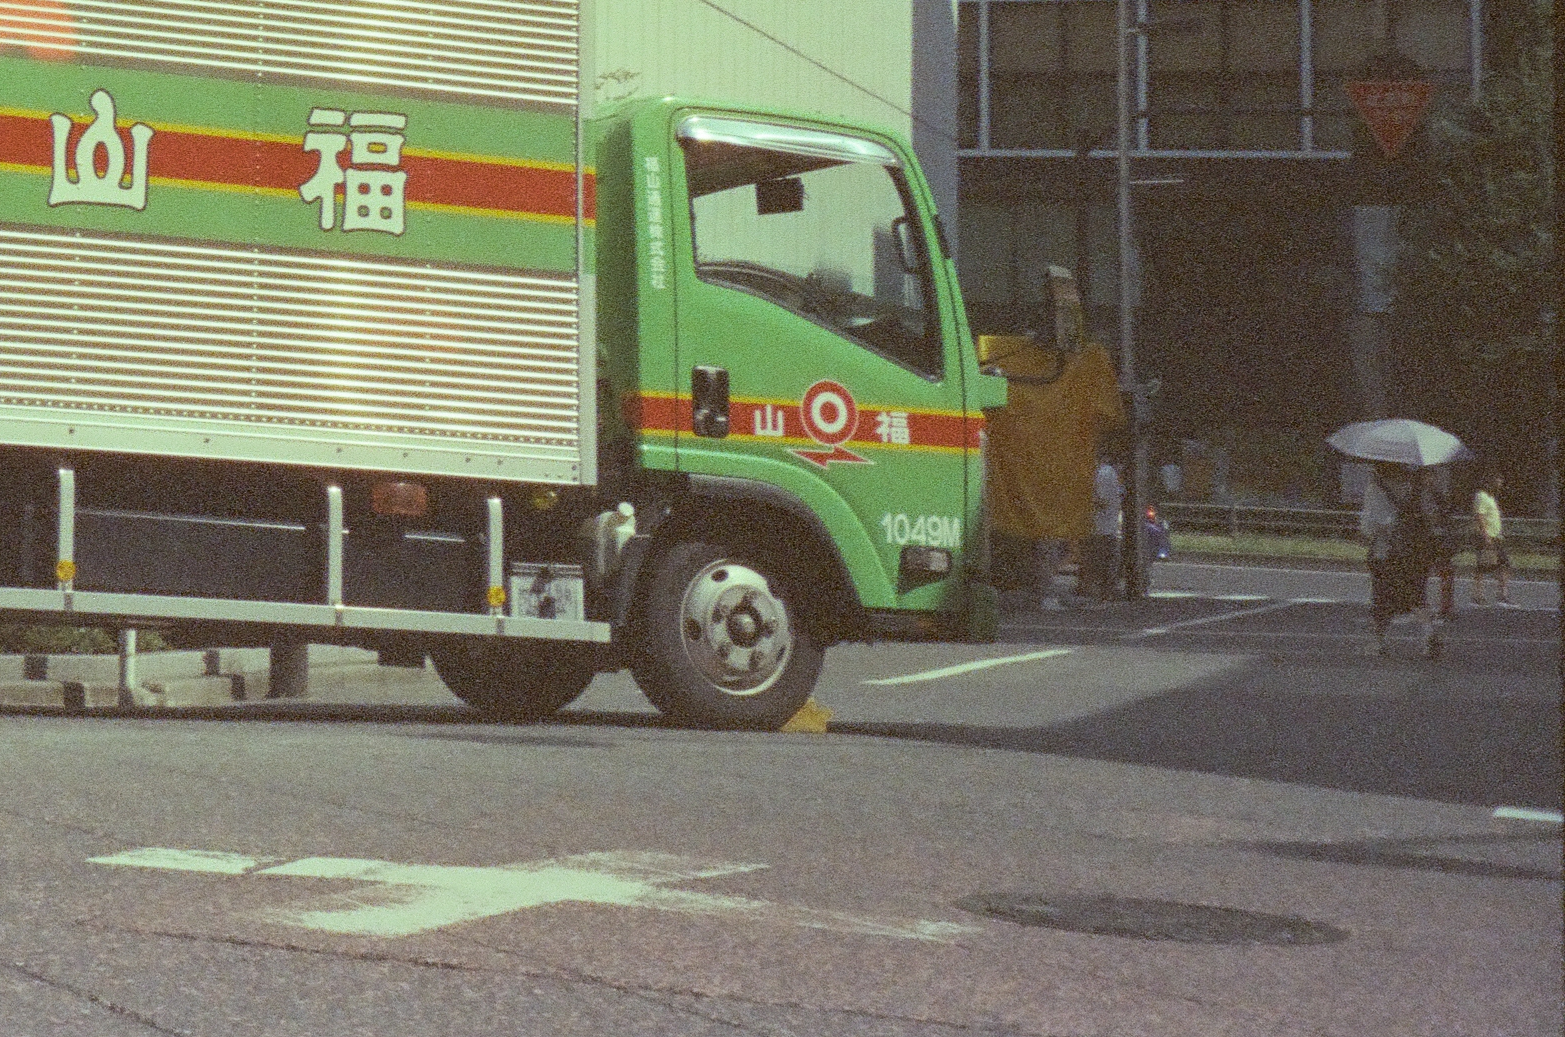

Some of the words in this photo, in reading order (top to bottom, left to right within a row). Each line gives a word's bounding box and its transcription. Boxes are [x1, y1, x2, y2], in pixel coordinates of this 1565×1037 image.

[47, 88, 155, 211] 山
[297, 107, 408, 236] 福
[753, 403, 784, 437] 山
[875, 410, 911, 444] 福
[880, 512, 962, 548] 1049M
